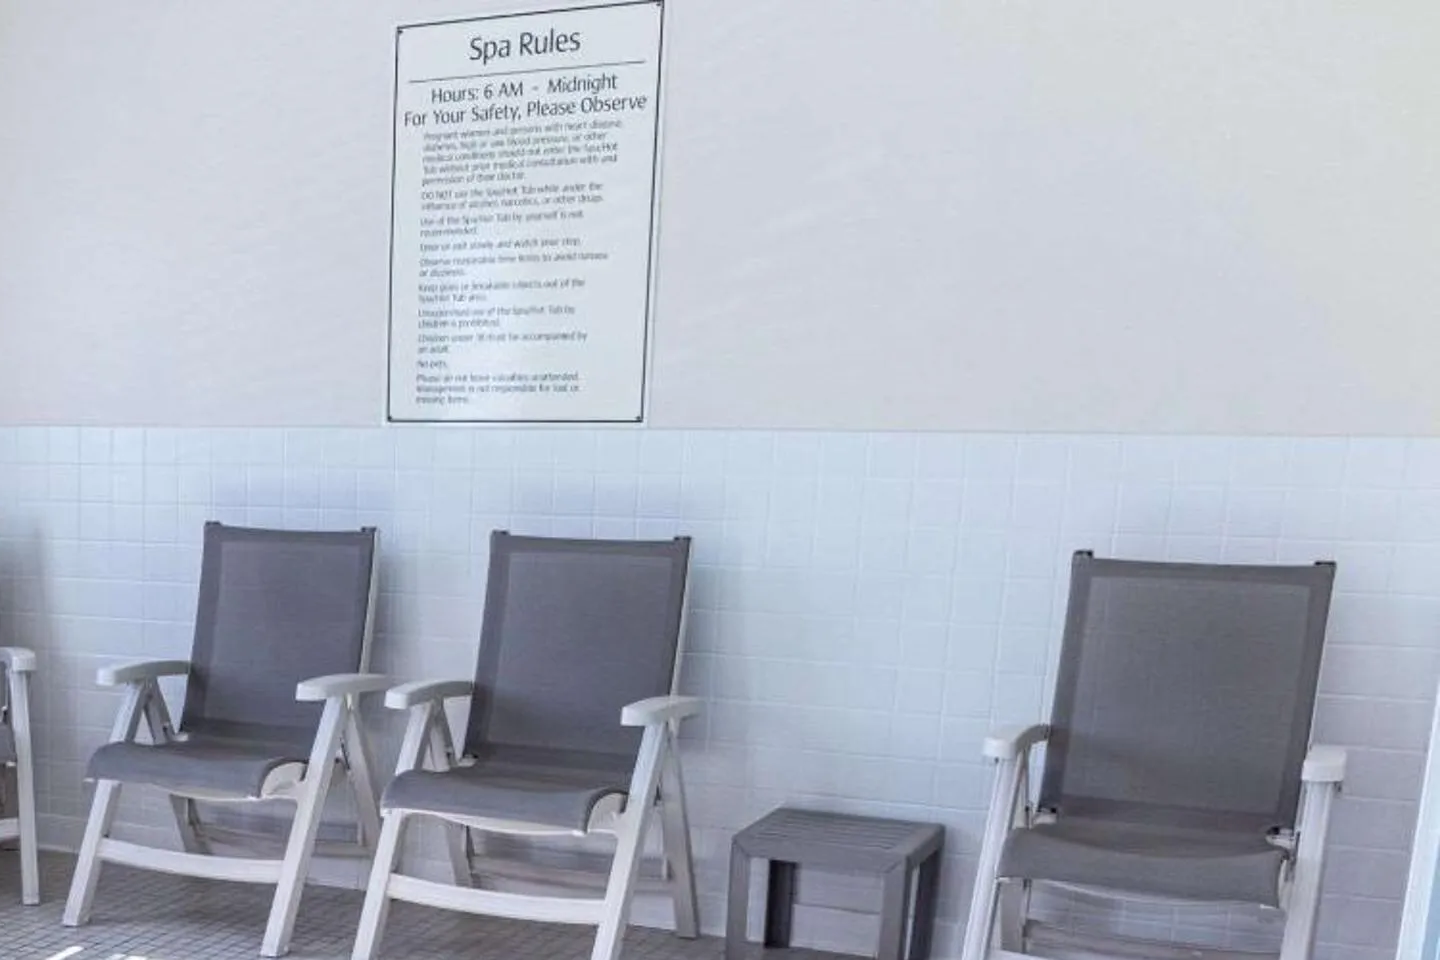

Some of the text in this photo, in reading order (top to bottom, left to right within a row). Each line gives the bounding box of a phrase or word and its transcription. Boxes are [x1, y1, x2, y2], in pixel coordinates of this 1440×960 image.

[469, 30, 581, 65] Spa Rules
[431, 86, 479, 104] Hours:
[483, 83, 493, 100] 6
[498, 81, 524, 98] AM
[546, 73, 619, 95] Midnight
[404, 94, 648, 127] For Your Safety, Please Observe
